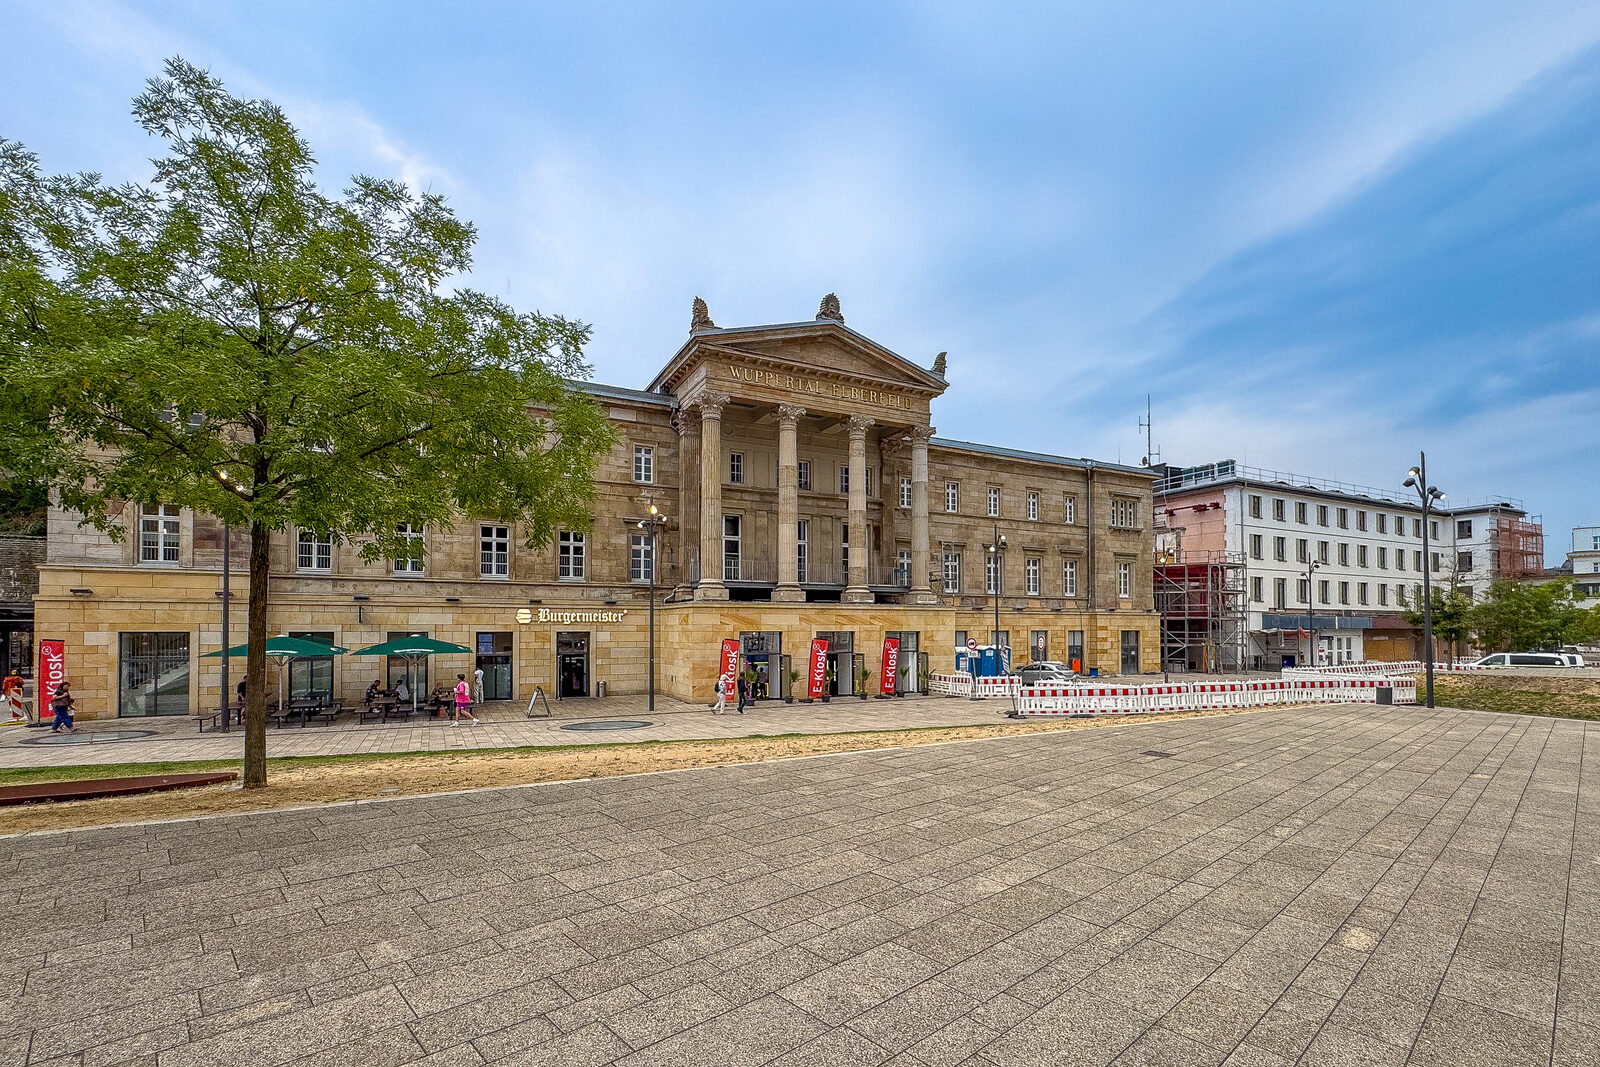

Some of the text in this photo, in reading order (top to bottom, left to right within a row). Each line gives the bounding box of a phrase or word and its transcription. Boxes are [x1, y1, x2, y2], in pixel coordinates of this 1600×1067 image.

[730, 365, 912, 409] WUPPERTAL ELBERFELD
[538, 608, 624, 625] Burgermeister
[725, 650, 738, 696] E-Kiosk
[811, 648, 827, 693] E-Kiosk
[884, 647, 898, 689] E-Kiosk
